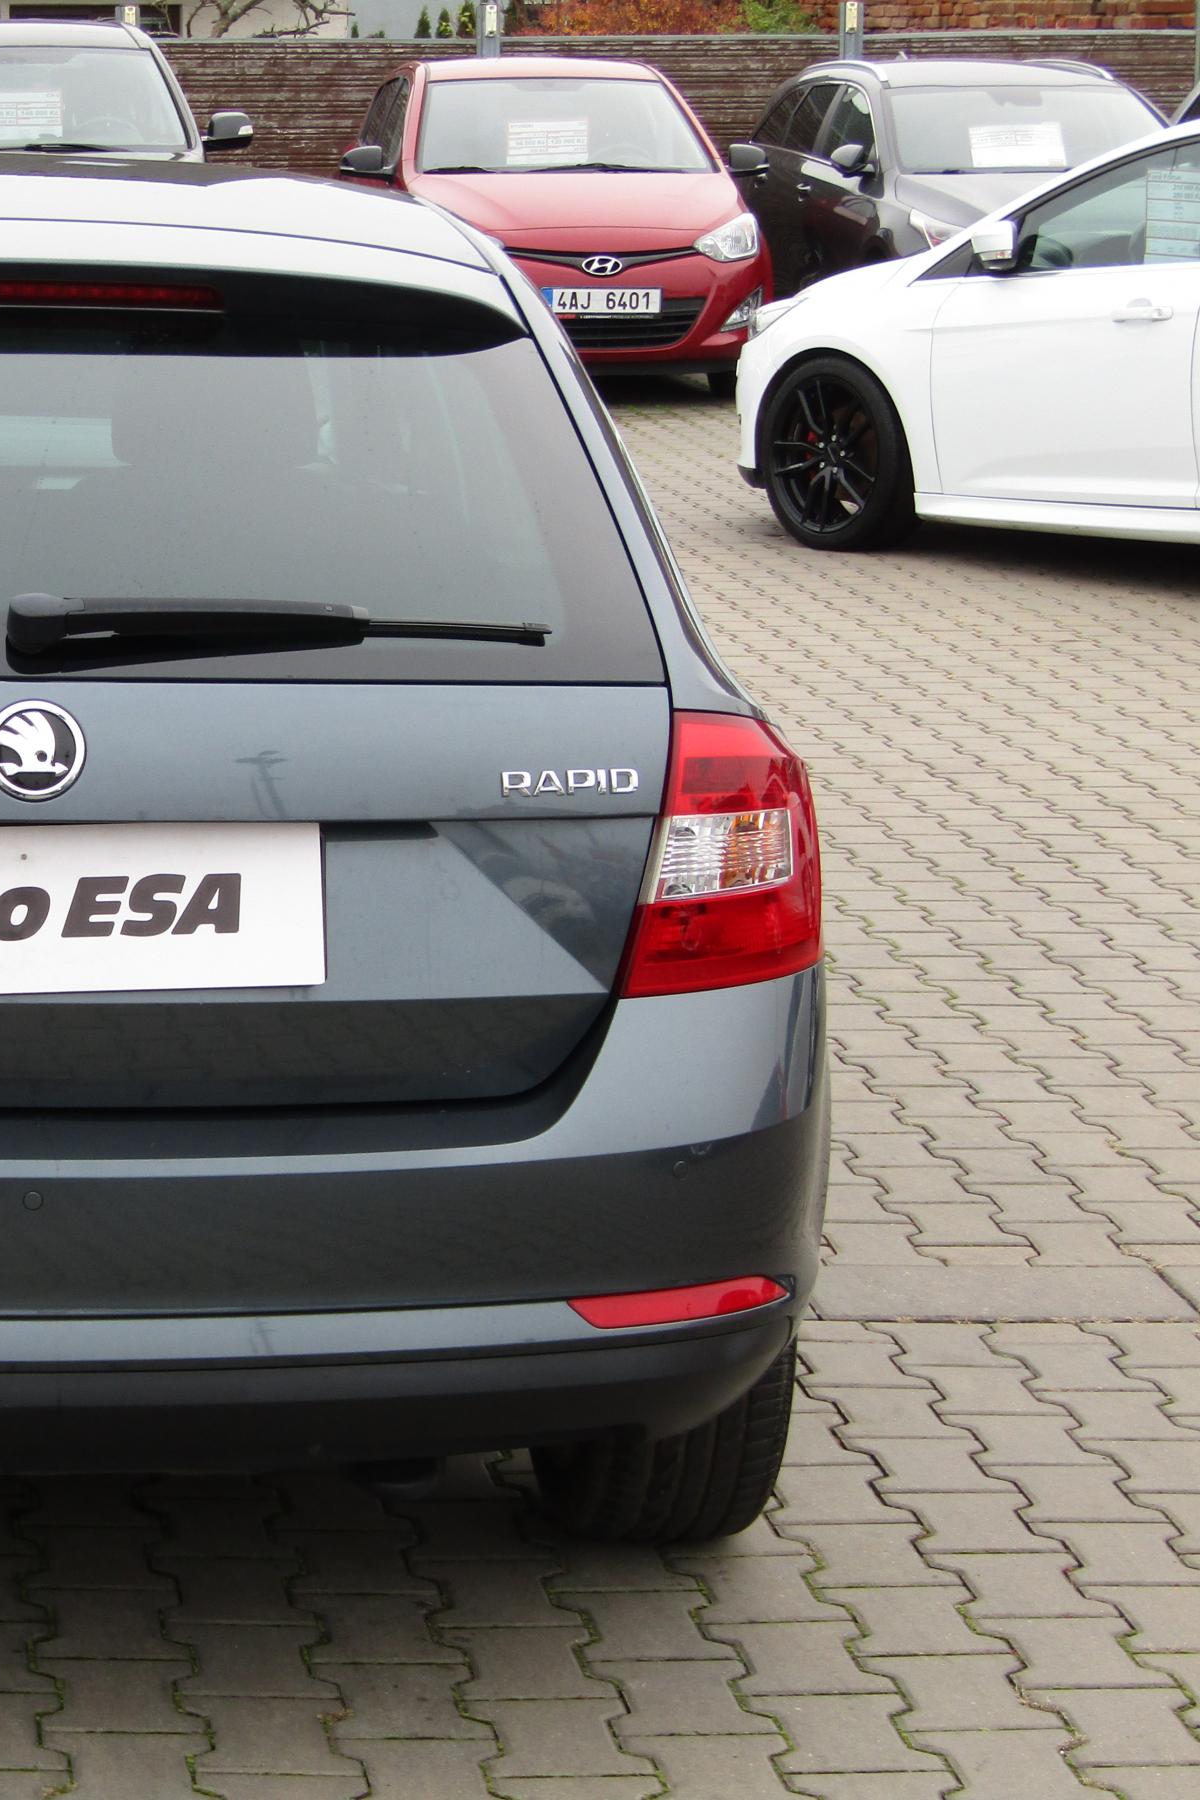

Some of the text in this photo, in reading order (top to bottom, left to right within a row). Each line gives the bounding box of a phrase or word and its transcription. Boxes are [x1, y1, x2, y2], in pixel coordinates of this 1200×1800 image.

[557, 291, 651, 310] 4AJ 6401
[501, 768, 639, 797] RAPID
[61, 873, 242, 938] ESA
